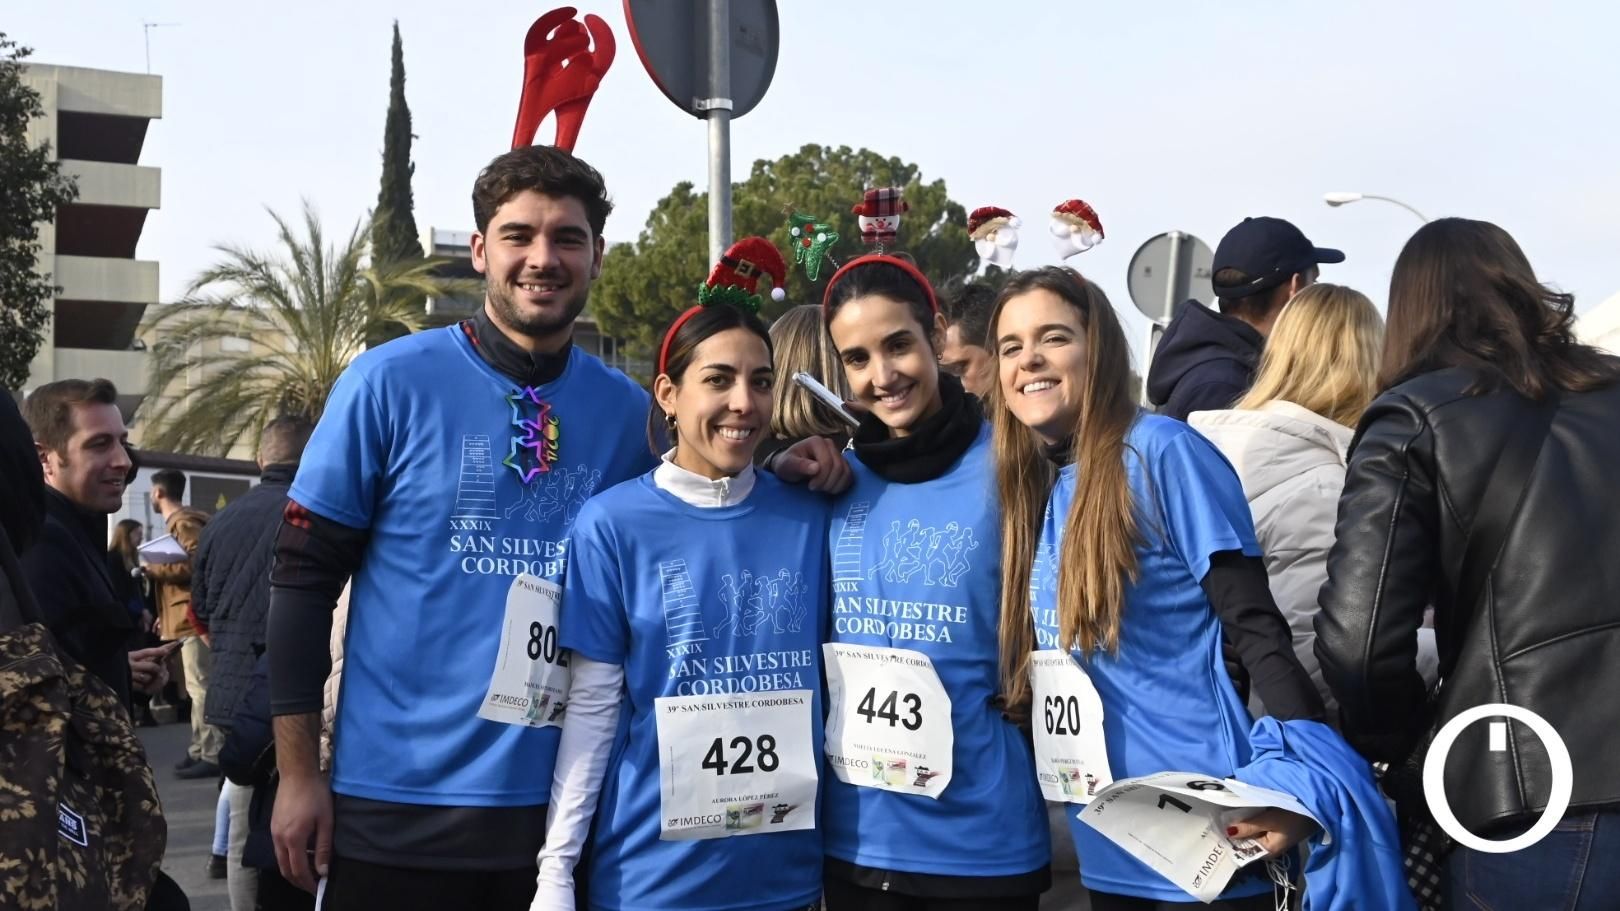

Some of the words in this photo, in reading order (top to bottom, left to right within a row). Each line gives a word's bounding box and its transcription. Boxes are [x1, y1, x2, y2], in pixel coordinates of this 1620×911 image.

[450, 520, 492, 531] XXXIX
[450, 535, 496, 553] SAN
[502, 537, 572, 558] SILVES
[865, 597, 967, 624] SILVESTRE
[835, 617, 952, 643] CORDOBESA
[667, 643, 703, 658] XXXIX
[847, 651, 861, 659] SAN
[668, 658, 707, 680] SAN
[714, 650, 811, 674] SILVESTRE
[677, 672, 803, 697] CORDOBESA
[499, 694, 529, 708] IMDECO
[681, 704, 699, 713] SAN
[701, 699, 750, 712] SILVESTRE
[751, 697, 804, 708] CORDOBESA
[857, 687, 923, 731] 443
[1044, 695, 1081, 736] 620
[701, 734, 780, 776] 428
[834, 755, 869, 769] IMDECO
[680, 814, 722, 827] IMDECO
